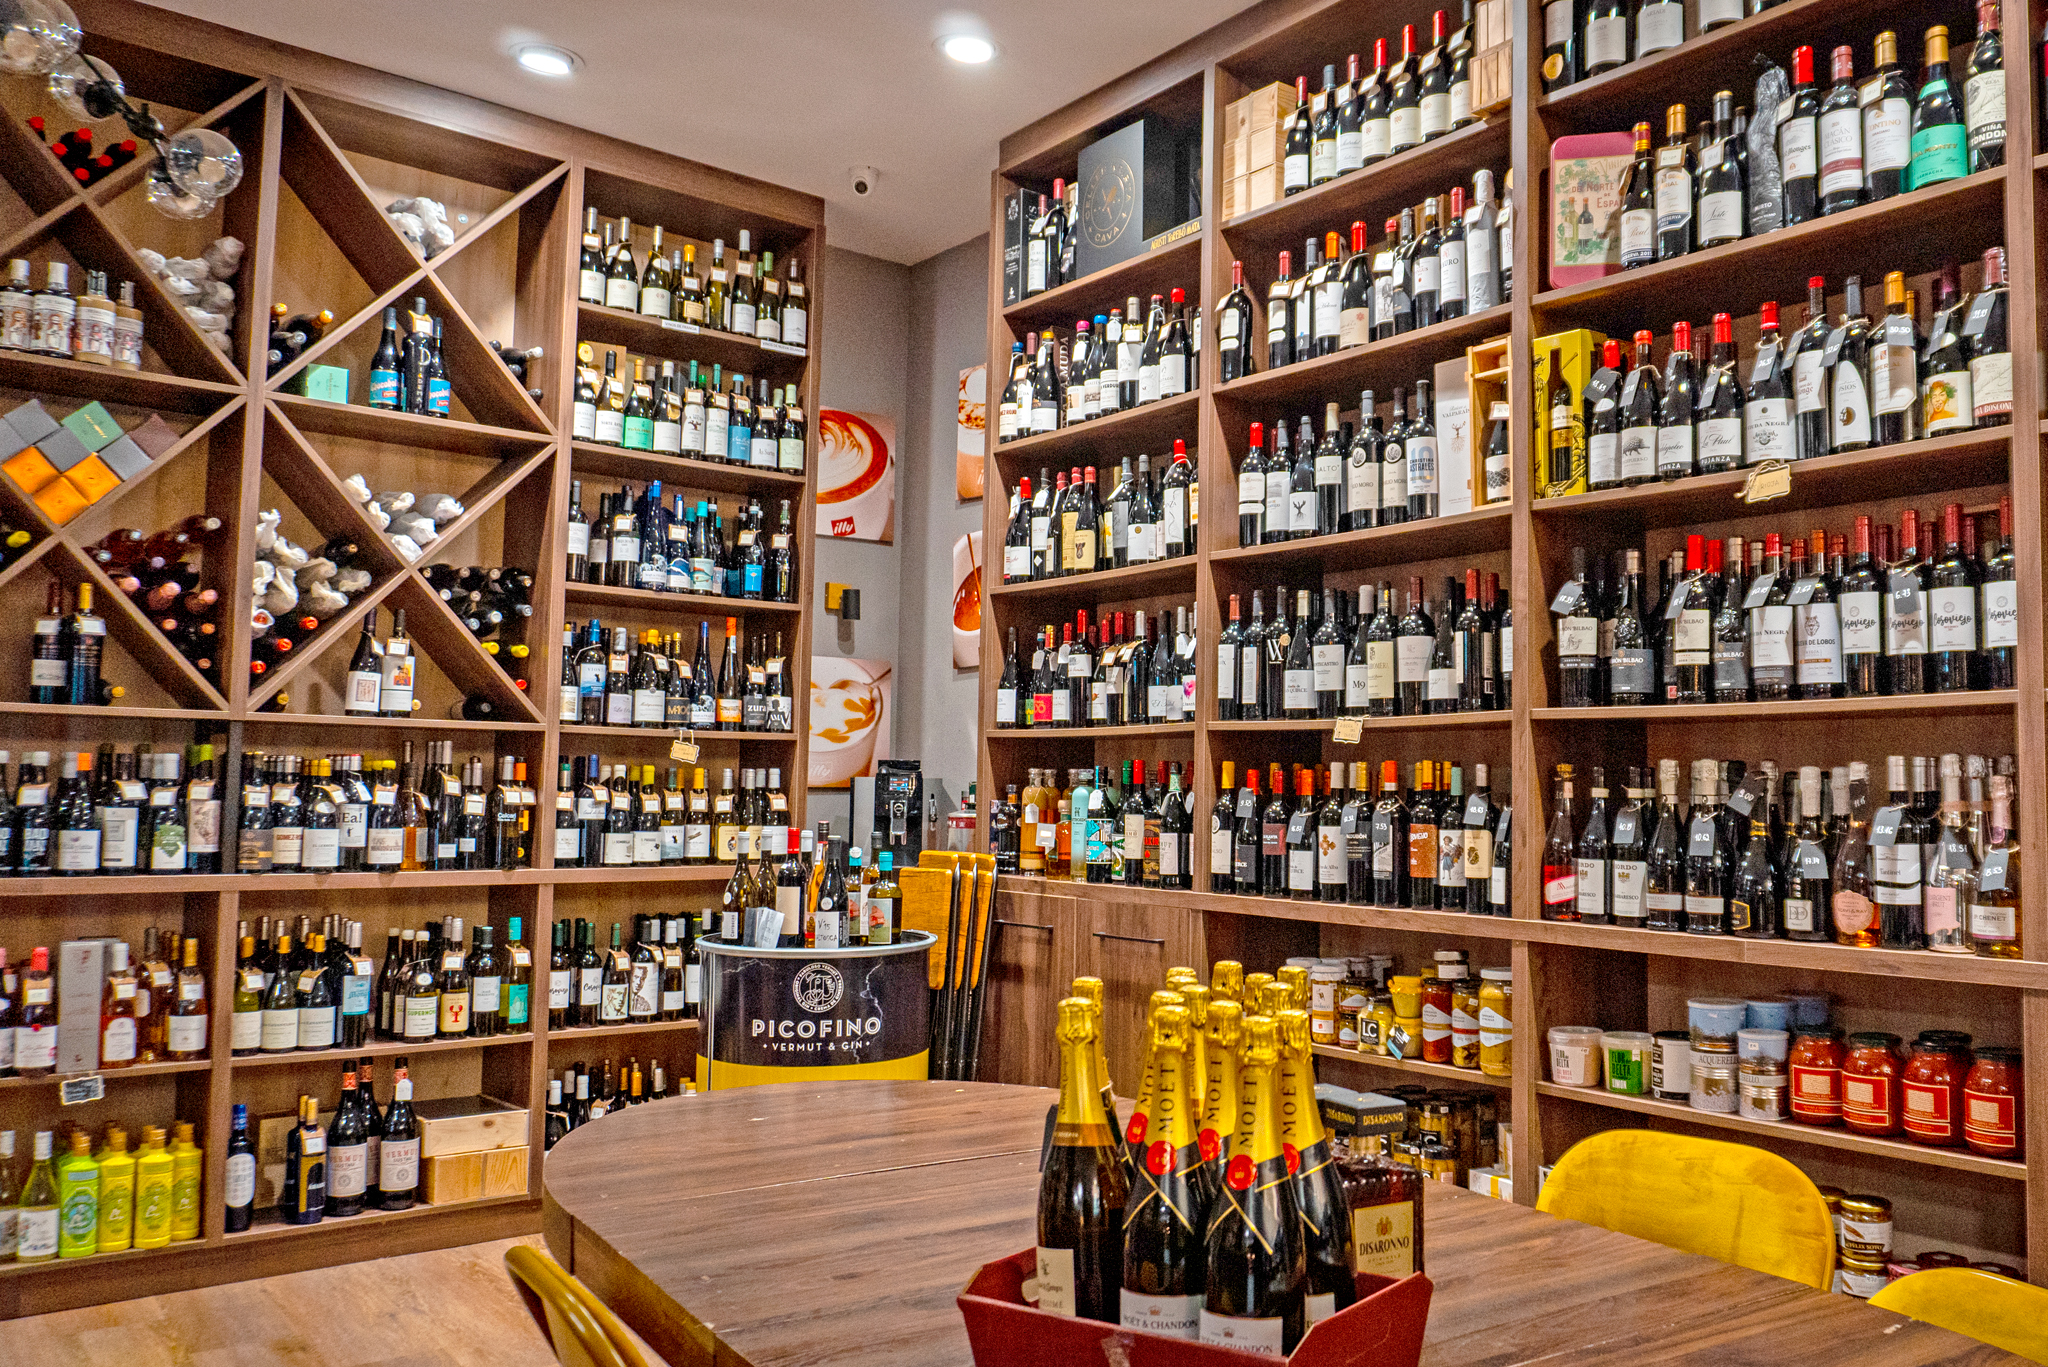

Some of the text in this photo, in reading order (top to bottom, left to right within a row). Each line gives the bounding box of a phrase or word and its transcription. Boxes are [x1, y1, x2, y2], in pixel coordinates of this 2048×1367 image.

[1982, 123, 2004, 133] VIÑA
[1971, 129, 2007, 145] TONDON
[1586, 181, 1615, 194] NORTE
[1597, 196, 1622, 209] ESPA
[1094, 226, 1120, 242] CAVA
[1760, 478, 1780, 490] RIOJA
[833, 520, 853, 534] illy
[1764, 628, 1790, 637] NEGRA
[1622, 656, 1644, 664] BILBAO
[1722, 651, 1745, 659] BILBAO
[1352, 680, 1366, 691] M9
[1981, 914, 2007, 922] CHENET
[752, 1016, 882, 1039] PICOFINO
[1362, 1020, 1378, 1038] LC
[772, 1041, 863, 1052] VERMUT & GIN
[1611, 1063, 1632, 1077] DELTA
[1362, 1111, 1404, 1126] DISARONNO
[1358, 1236, 1411, 1257] DISARONNO
[1142, 1318, 1150, 1329] &
[1150, 1318, 1199, 1331] CHANDON
